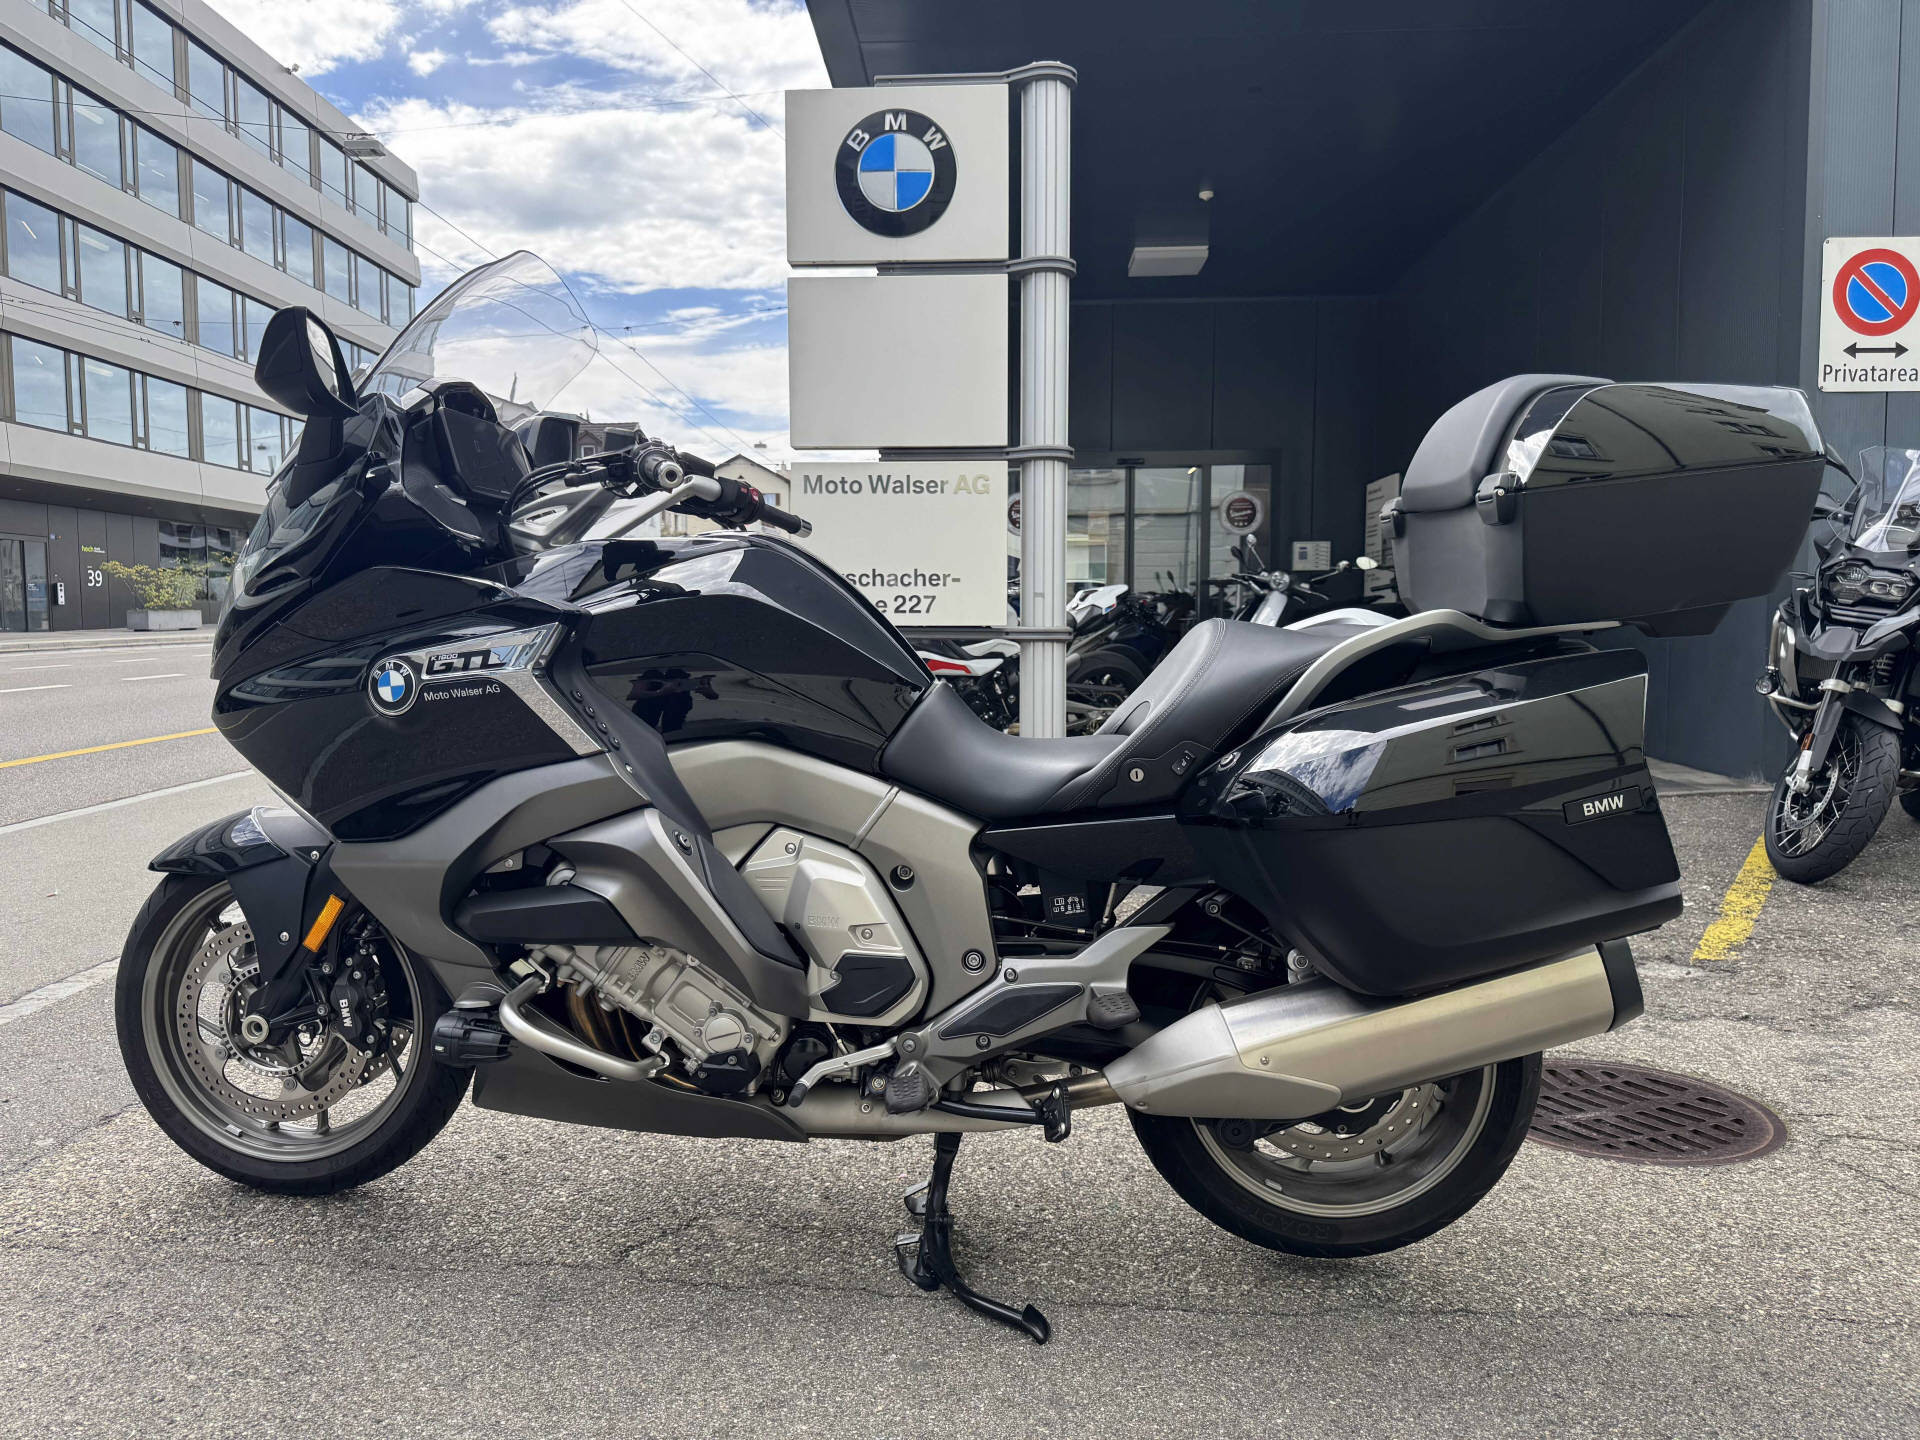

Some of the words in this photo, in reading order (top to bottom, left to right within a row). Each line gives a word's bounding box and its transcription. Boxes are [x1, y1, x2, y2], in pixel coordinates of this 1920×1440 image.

[846, 111, 947, 152] BMW
[1822, 363, 1919, 383] Privatarea
[803, 474, 863, 495] Moto
[868, 474, 949, 495] Walser
[953, 474, 991, 495] AG
[87, 569, 103, 587] 39
[842, 568, 961, 588] schacher-
[893, 594, 937, 614] 227
[372, 660, 411, 680] BMW
[426, 649, 507, 675] GTL
[423, 691, 450, 702] Moto
[450, 686, 483, 698] Walser
[485, 683, 501, 694] AG
[1582, 794, 1624, 817] BMW
[339, 998, 353, 1027] BMW
